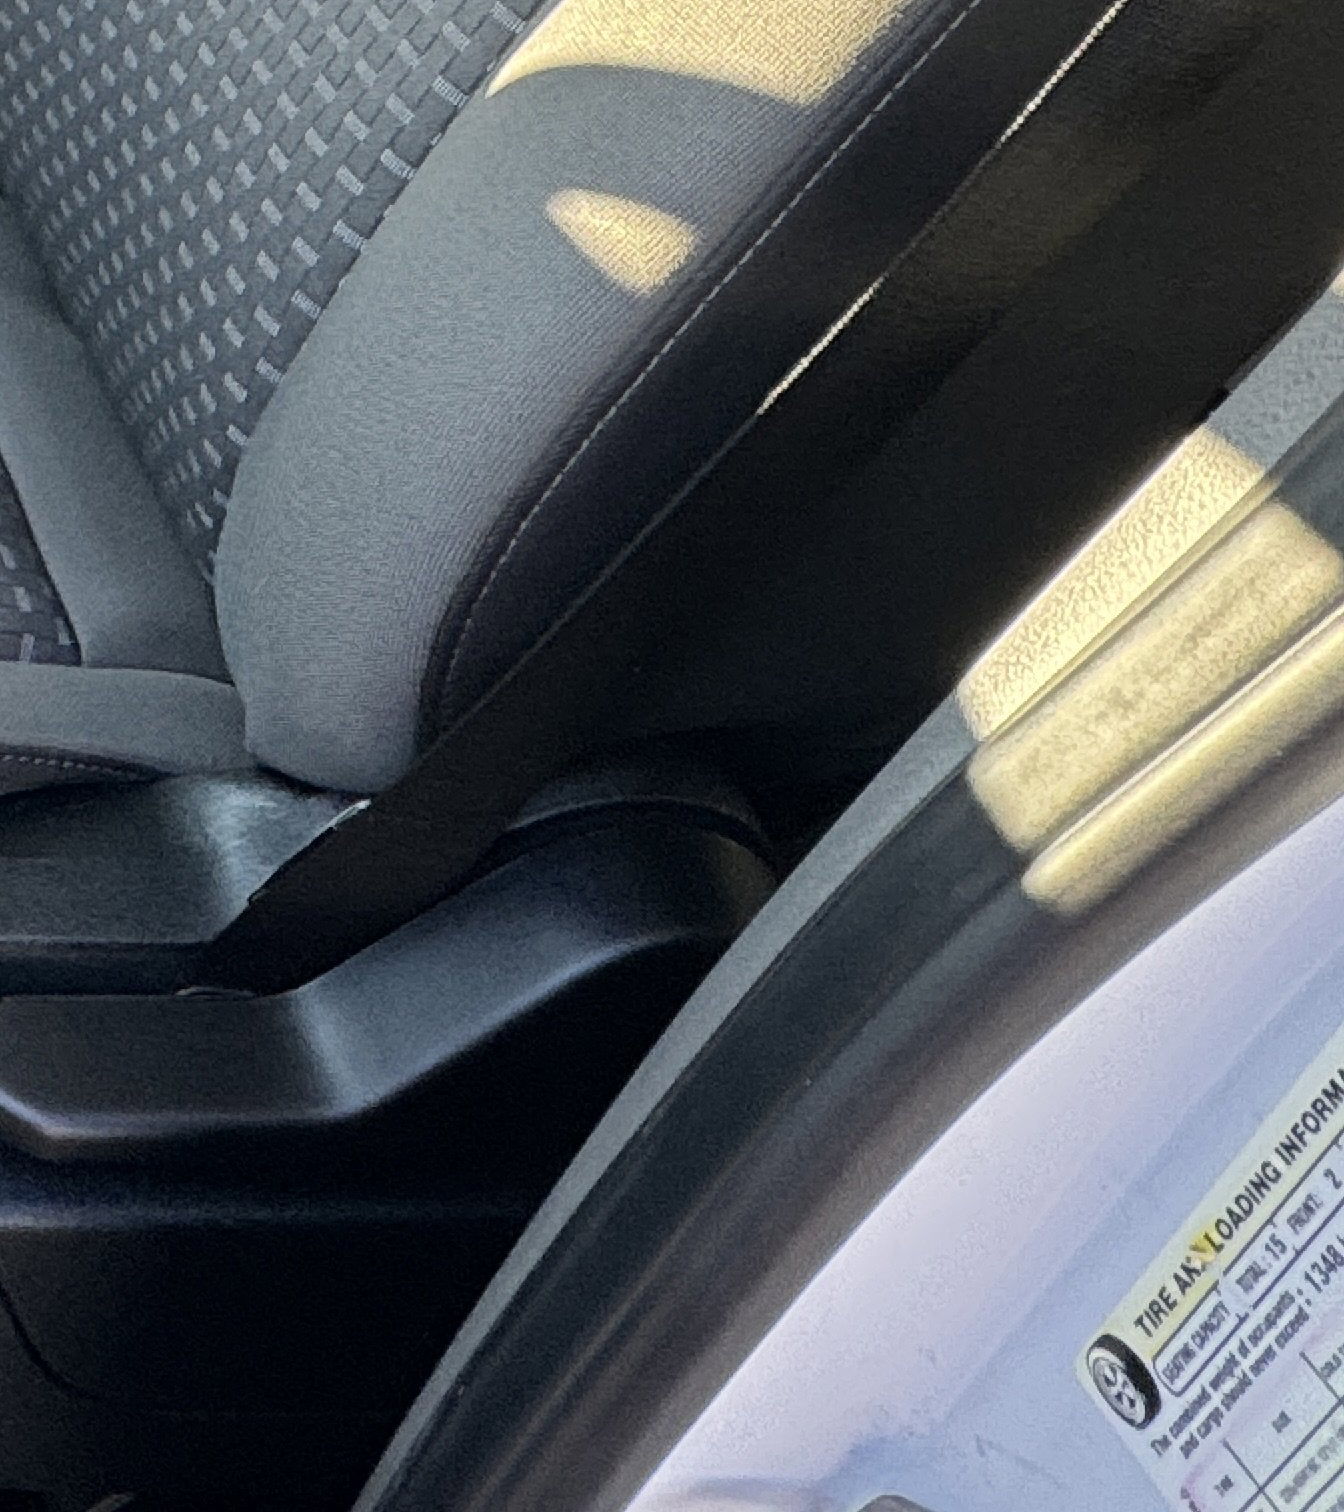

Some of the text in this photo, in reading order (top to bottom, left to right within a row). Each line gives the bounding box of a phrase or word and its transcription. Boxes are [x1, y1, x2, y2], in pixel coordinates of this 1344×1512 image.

[1133, 1286, 1179, 1338] TIRE
[1202, 1160, 1282, 1254] LOADING
[1265, 1232, 1288, 1262] 15
